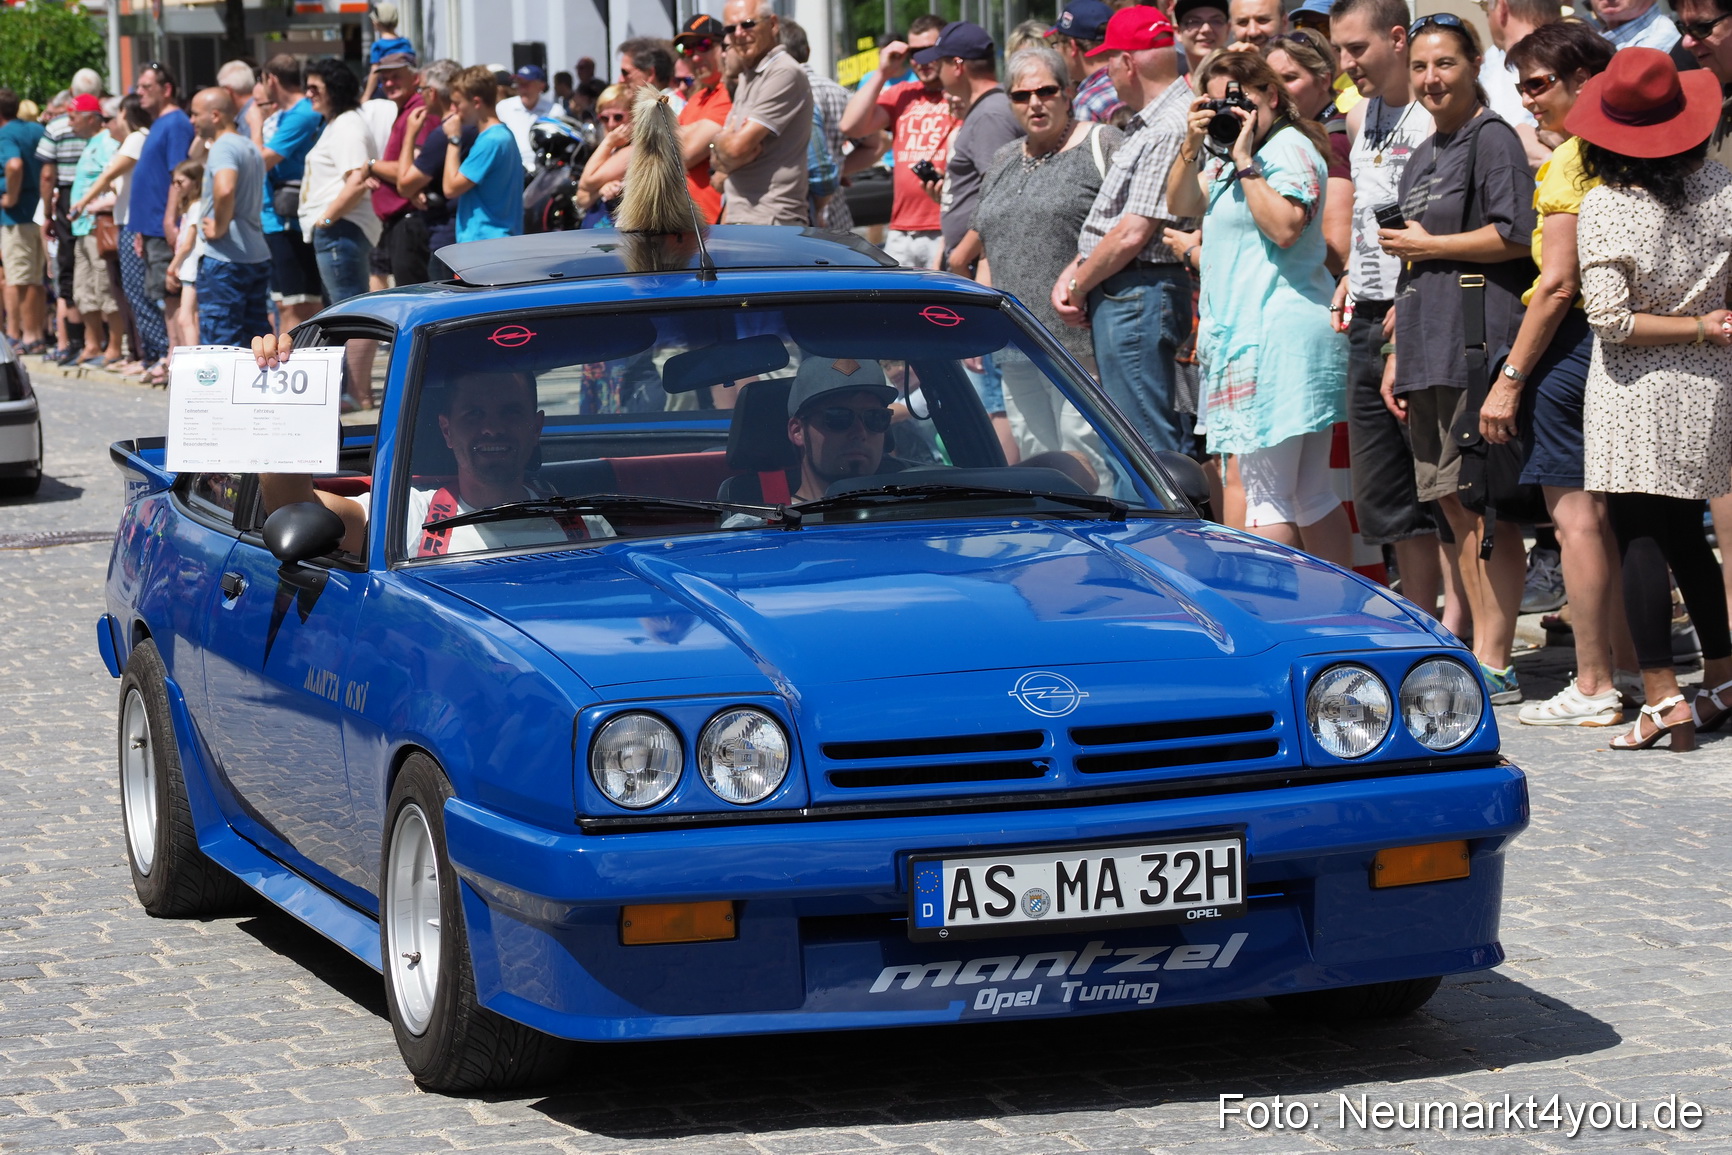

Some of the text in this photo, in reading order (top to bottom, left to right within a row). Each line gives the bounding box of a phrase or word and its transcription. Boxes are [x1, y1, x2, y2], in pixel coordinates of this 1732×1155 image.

[251, 369, 309, 395] 430
[303, 664, 340, 702] MANTA
[947, 864, 1016, 920] AS
[1056, 857, 1124, 913] MA
[1140, 847, 1237, 906] 32H
[922, 902, 934, 918] D
[1186, 908, 1222, 920] OPEL
[868, 932, 1249, 994] mantzel
[973, 980, 1160, 1015] Opel Tuning
